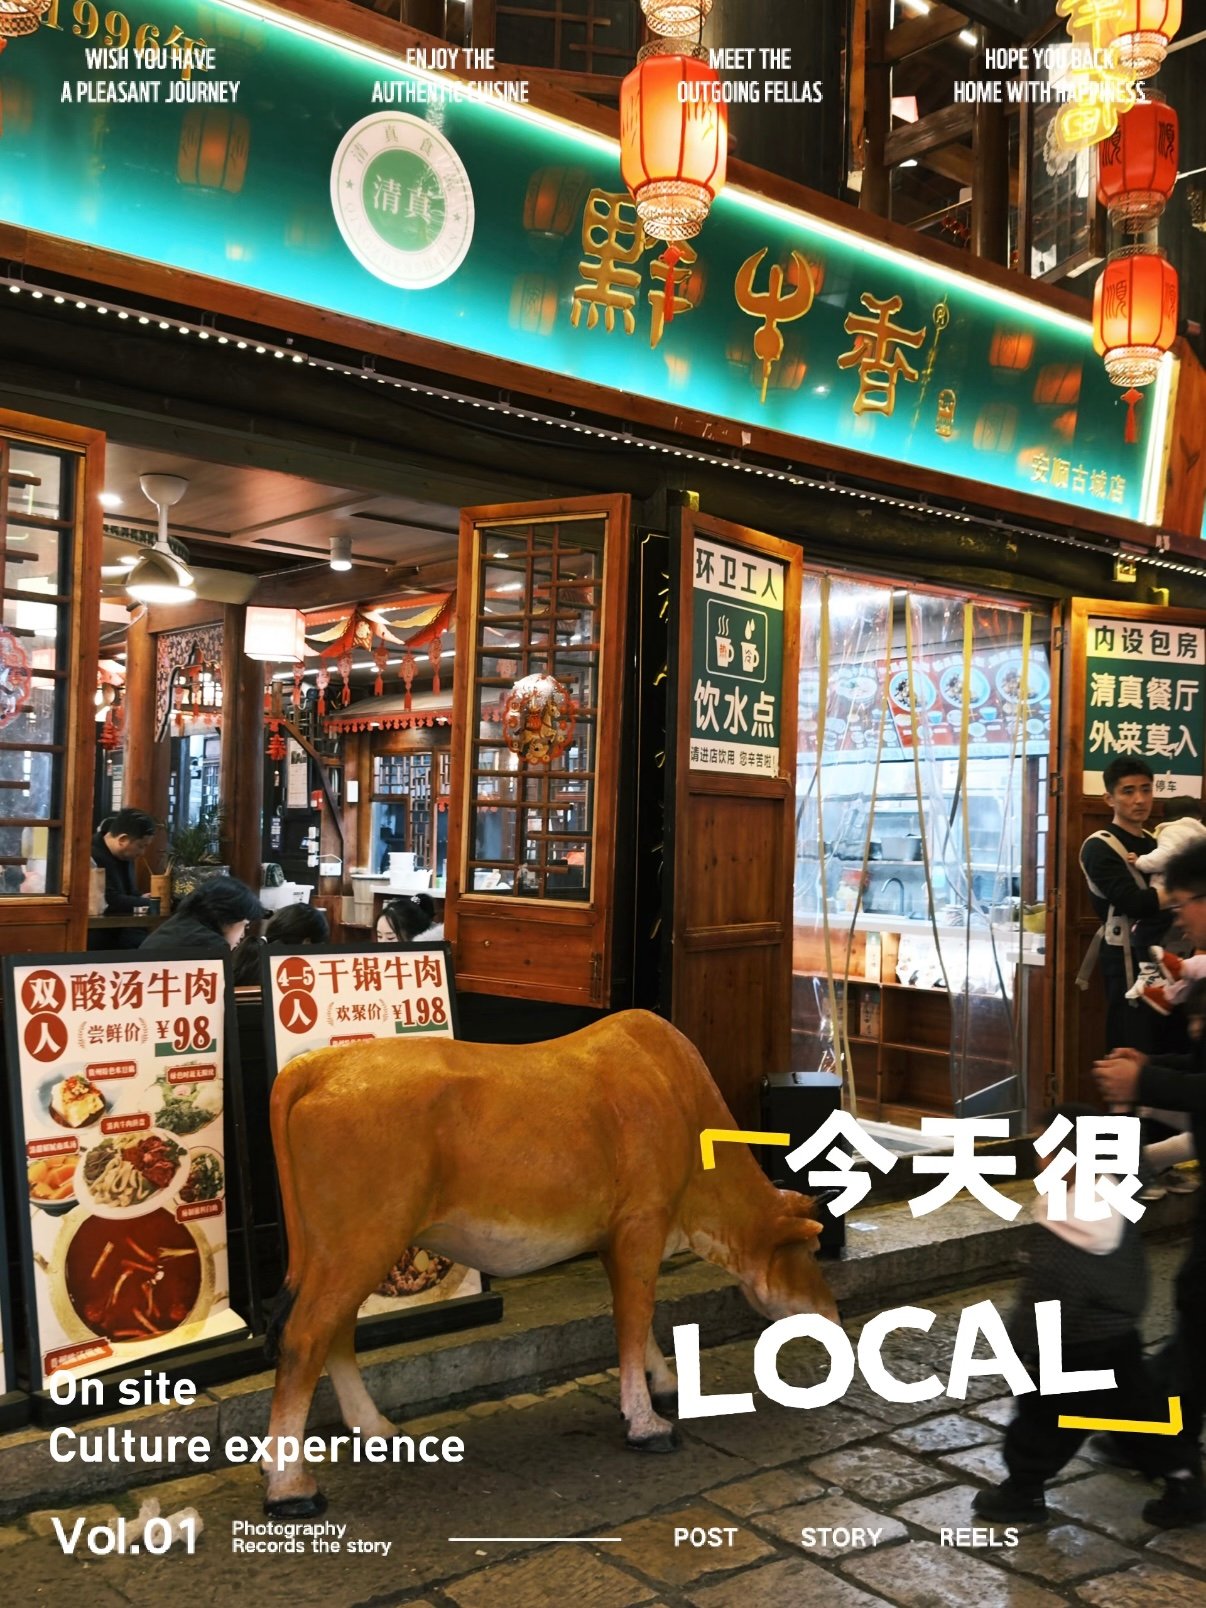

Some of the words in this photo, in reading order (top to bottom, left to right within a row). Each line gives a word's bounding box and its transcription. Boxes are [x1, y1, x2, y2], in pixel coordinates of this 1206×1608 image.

[373, 174, 432, 223] 清真
[1030, 452, 1127, 505] 安顺古城店
[695, 547, 778, 602] 环卫工人
[1094, 625, 1199, 659] 内设包房
[693, 678, 776, 739] 饮水点
[1090, 671, 1200, 712] 清真餐厅
[690, 746, 735, 766] 请进店饮用
[1088, 719, 1199, 758] 外菜莫入
[70, 967, 218, 1012] 酸汤牛肉
[318, 955, 443, 994] 干锅牛肉
[336, 1003, 382, 1023] 欢聚价
[392, 996, 447, 1026] ¥198
[87, 1022, 141, 1045] 尝鲜价
[155, 1015, 211, 1051] ¥98
